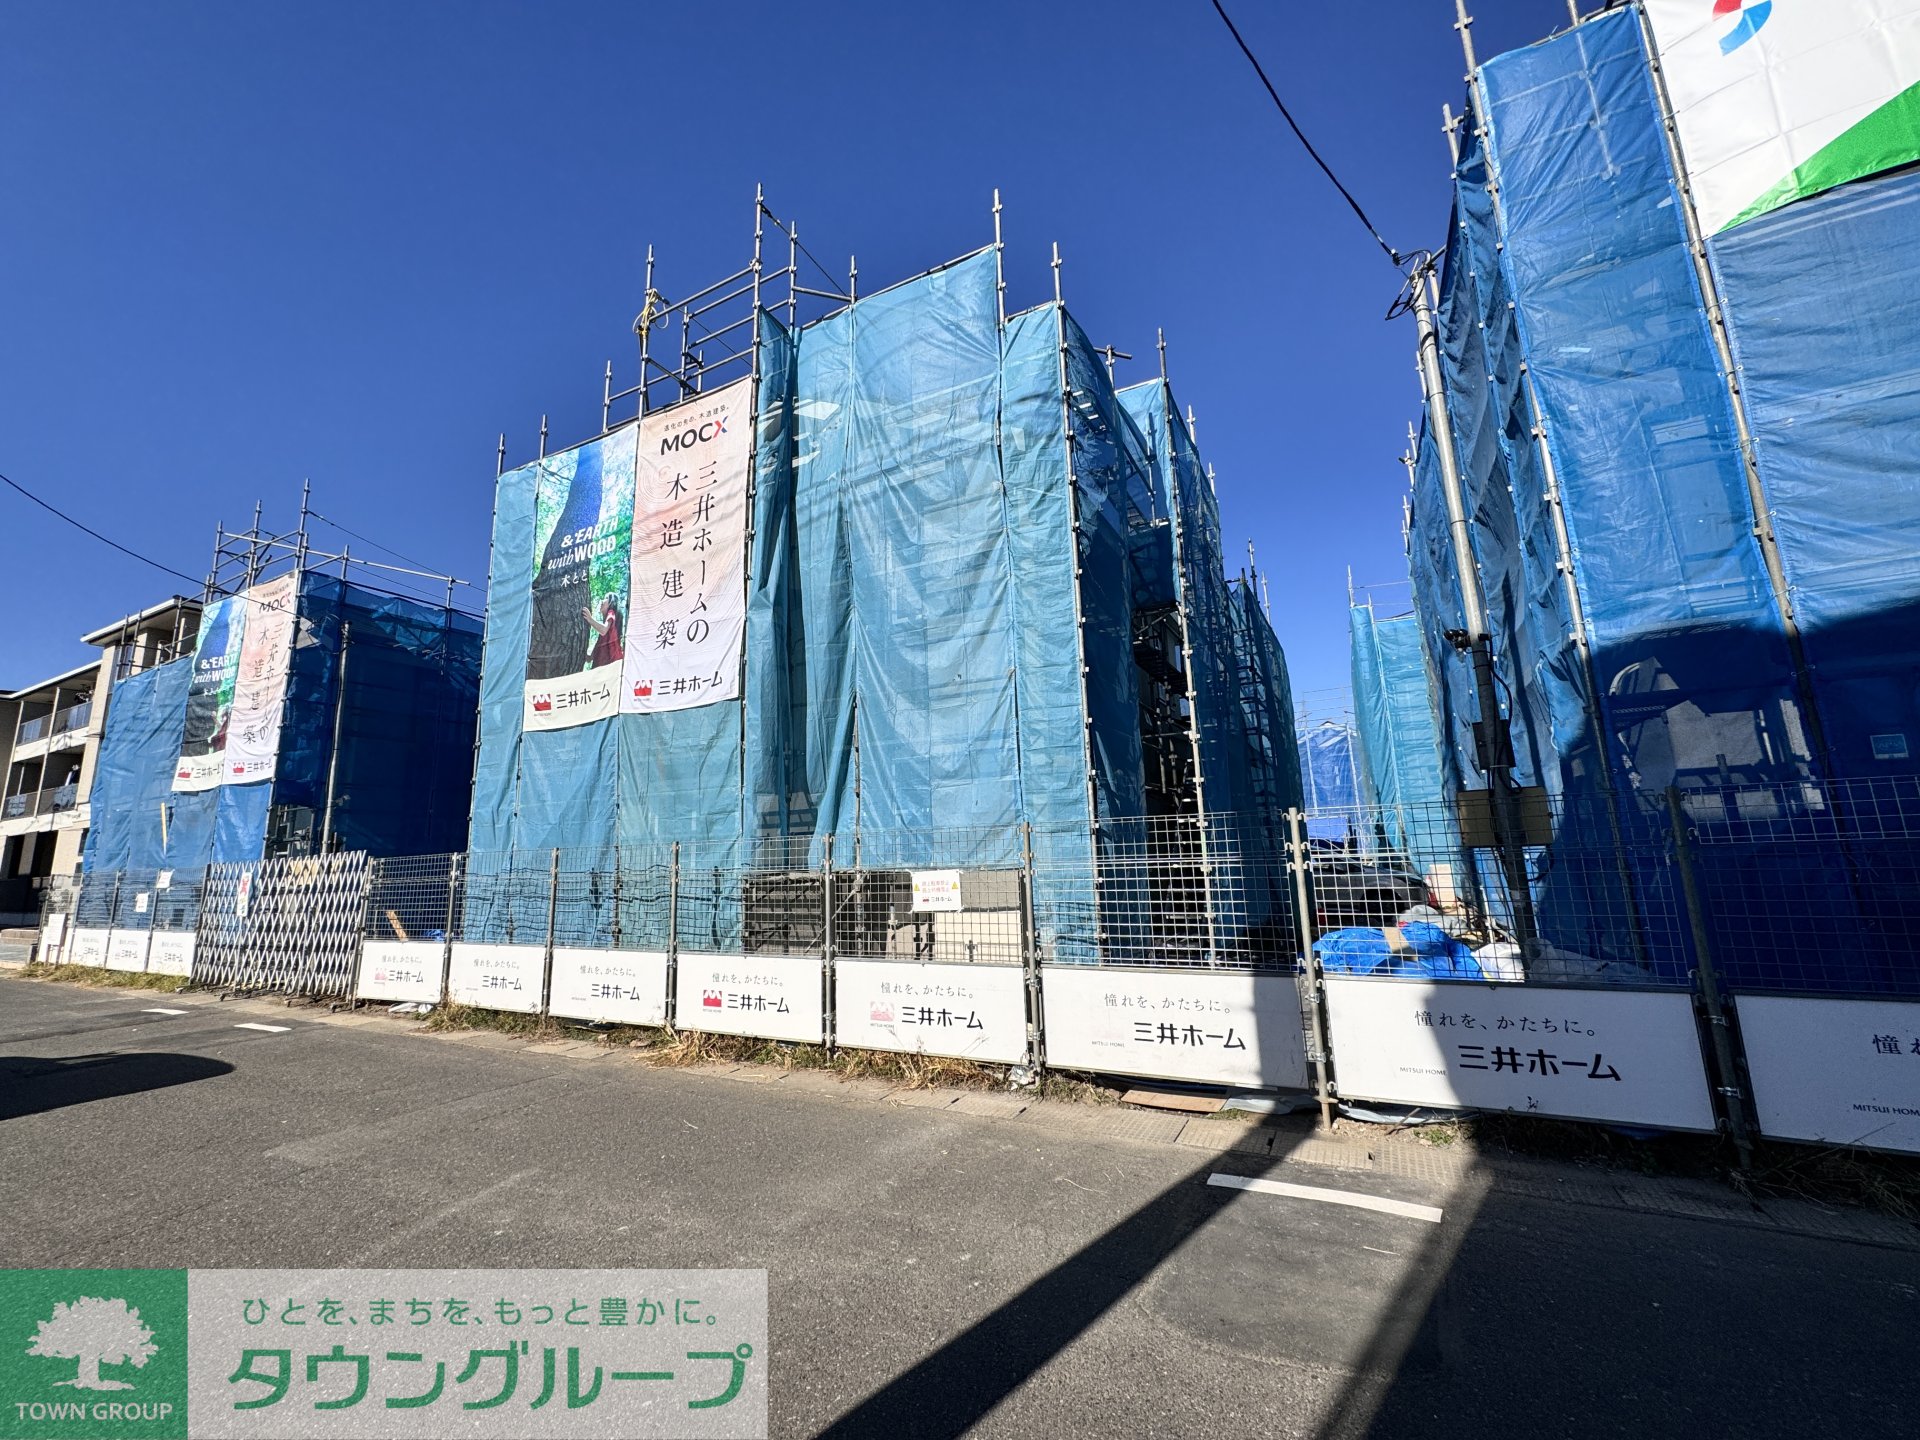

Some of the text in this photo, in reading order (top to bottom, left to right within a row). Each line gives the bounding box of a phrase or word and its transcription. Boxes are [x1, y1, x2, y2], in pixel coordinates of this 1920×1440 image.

[660, 415, 729, 456] MOCX
[654, 472, 689, 651] 木造建築
[686, 460, 718, 645] 三井ホームの
[656, 671, 723, 696] 三井ホーム
[556, 683, 611, 710] 三井ホーム
[388, 970, 424, 983] 三井ホーム
[482, 975, 522, 991] 三井ホーム
[590, 983, 641, 1001] 三井ホーム
[727, 993, 790, 1014] 三井ホーム
[1104, 992, 1231, 1015] 憧れを、かたちに。
[901, 1006, 984, 1030] 三井ホーム
[1415, 1010, 1596, 1038] 憧れを、かたちに。
[1134, 1022, 1247, 1051] 三井ホーム
[1399, 1066, 1424, 1074] MITSUI
[1457, 1044, 1622, 1082] 三井ホーム
[1853, 1103, 1890, 1114] MITSUI
